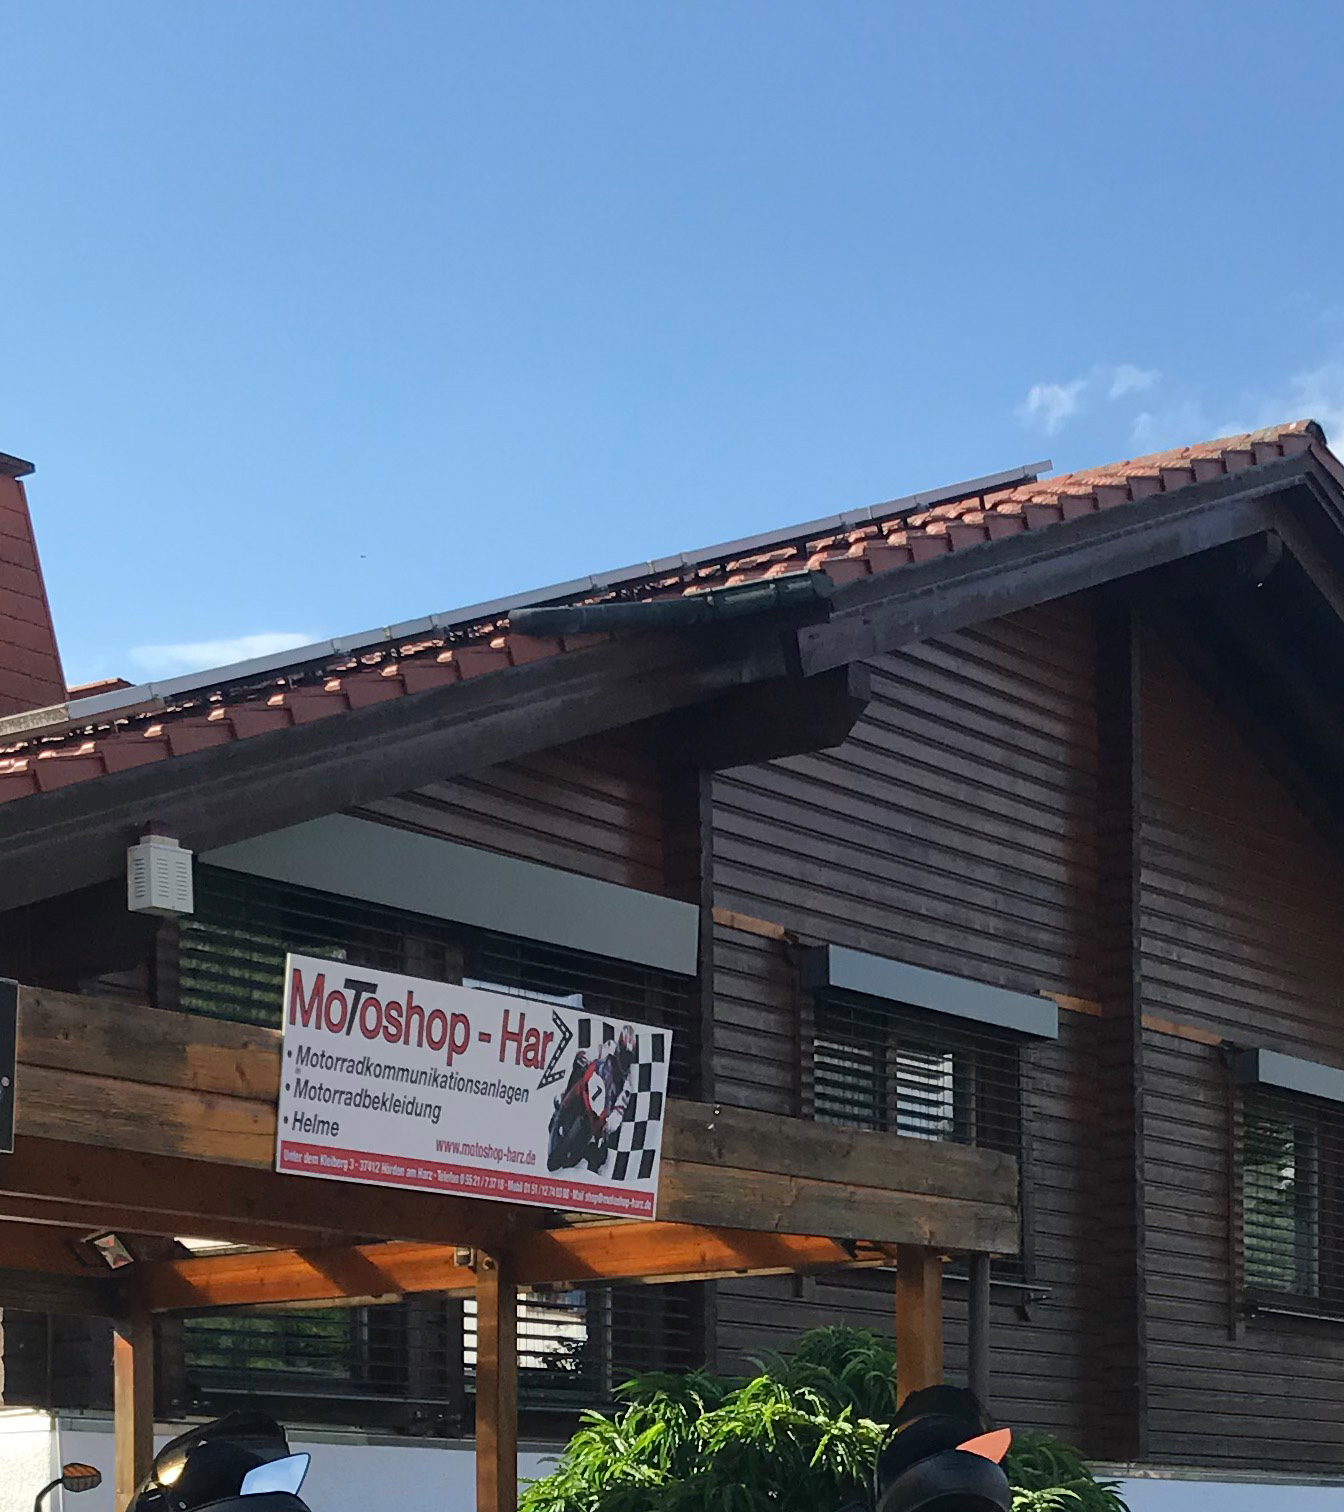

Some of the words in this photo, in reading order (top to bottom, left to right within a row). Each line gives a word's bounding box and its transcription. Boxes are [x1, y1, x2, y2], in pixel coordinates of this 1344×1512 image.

[295, 1045, 530, 1105] Motorradkommunikationsanlagen
[292, 1078, 442, 1125] Motorradbekleidung
[291, 1111, 340, 1138] Helme
[436, 1138, 537, 1166] www.motoshop-harz.de
